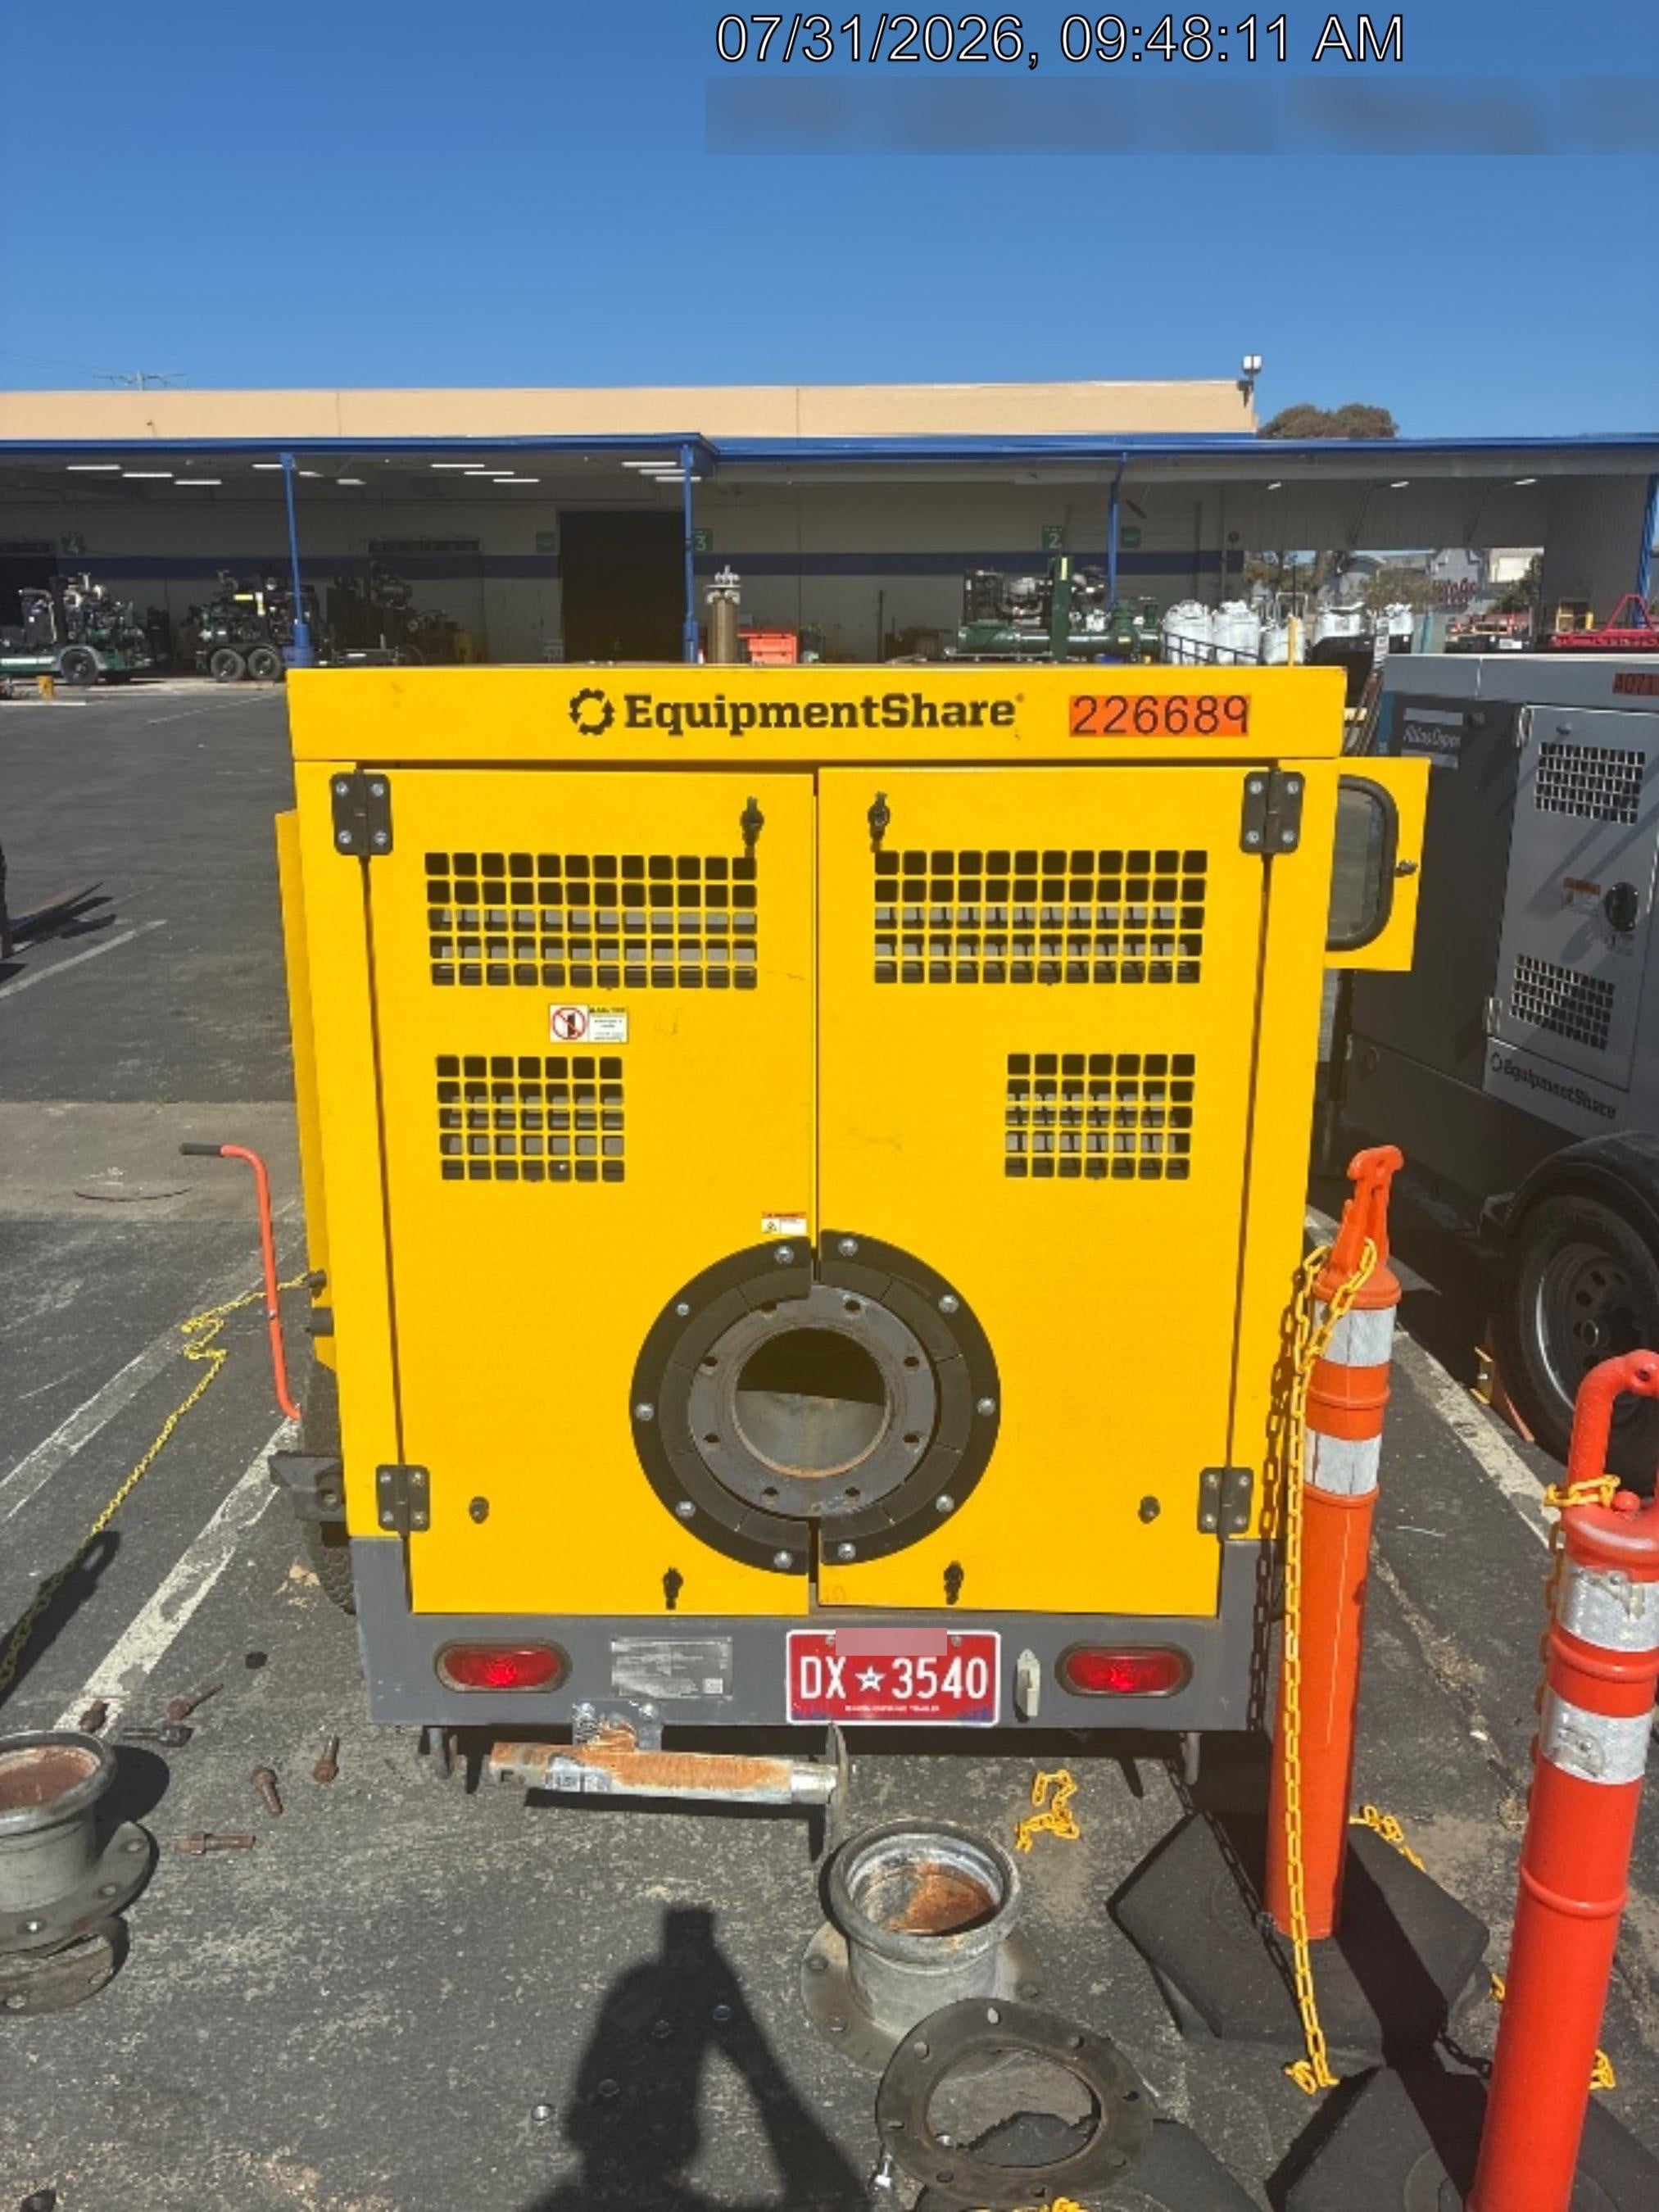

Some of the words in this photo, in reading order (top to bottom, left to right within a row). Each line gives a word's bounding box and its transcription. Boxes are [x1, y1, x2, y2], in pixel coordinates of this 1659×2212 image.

[1049, 533, 1063, 549] 2
[623, 693, 1015, 737] EquipmentShare
[1072, 695, 1248, 735] 226689
[1503, 1059, 1616, 1120] EquipmentShare
[800, 1656, 847, 1699] DX
[891, 1656, 989, 1700] 3540
